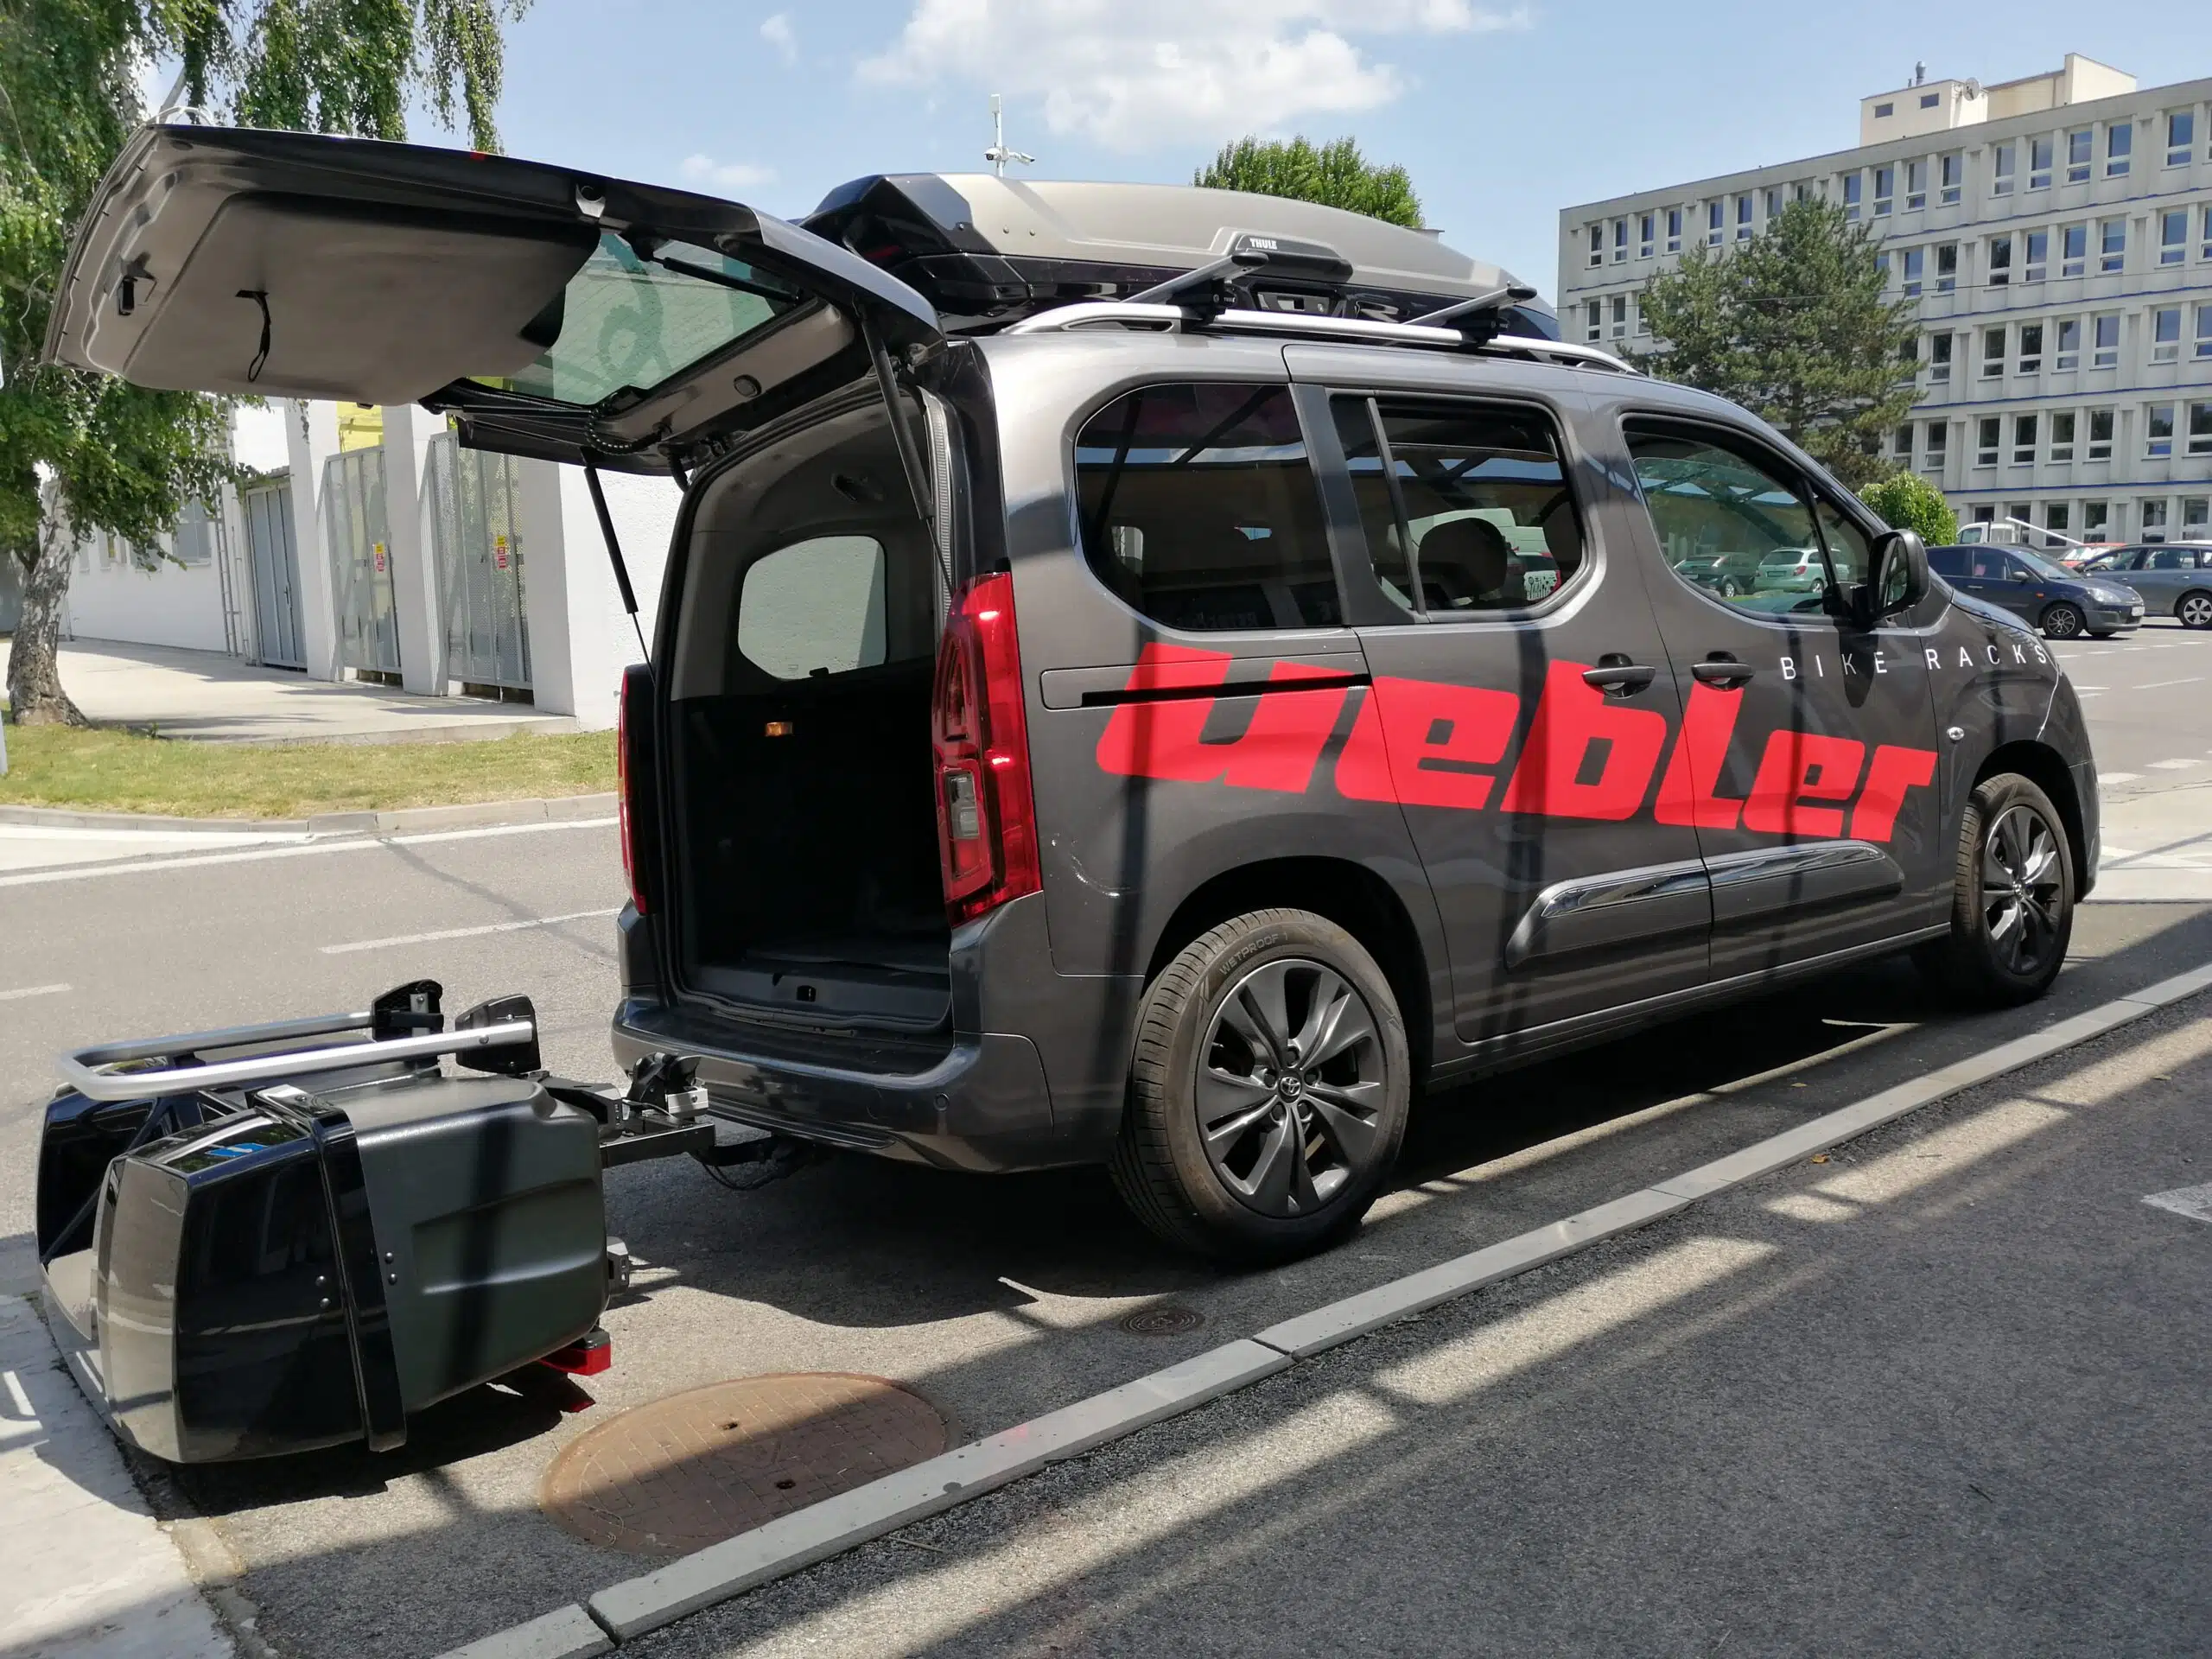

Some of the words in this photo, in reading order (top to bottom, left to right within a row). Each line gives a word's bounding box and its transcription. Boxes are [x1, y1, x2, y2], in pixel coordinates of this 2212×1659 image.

[1249, 238, 1277, 250] THULE
[1780, 652, 1888, 680] BIKE
[1925, 644, 2047, 670] RACKS
[1219, 933, 1279, 975] WETPROOF
